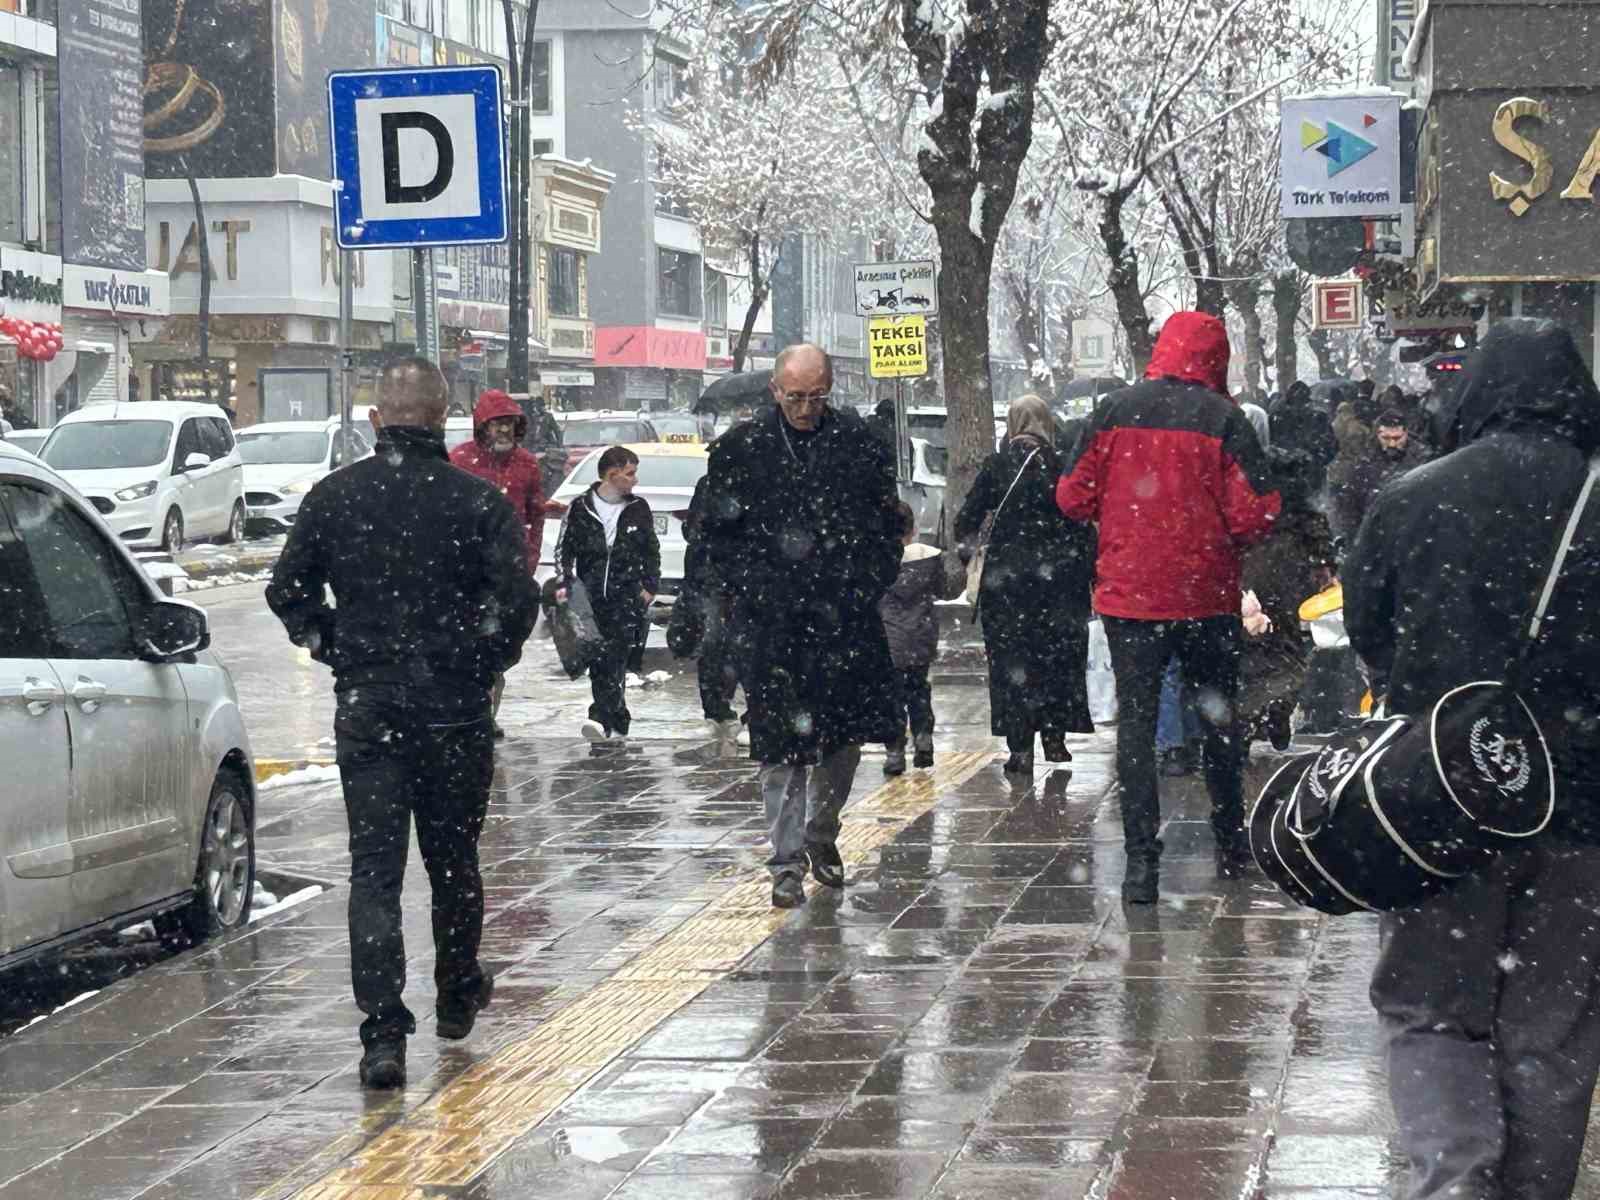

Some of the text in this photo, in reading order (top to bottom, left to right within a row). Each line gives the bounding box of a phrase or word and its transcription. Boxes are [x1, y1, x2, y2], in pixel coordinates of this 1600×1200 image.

[381, 111, 454, 204] D
[1292, 189, 1390, 205] Türk Telekom
[1326, 290, 1352, 320] E
[870, 326, 924, 341] TEKEL
[873, 341, 922, 358] TAKSİ
